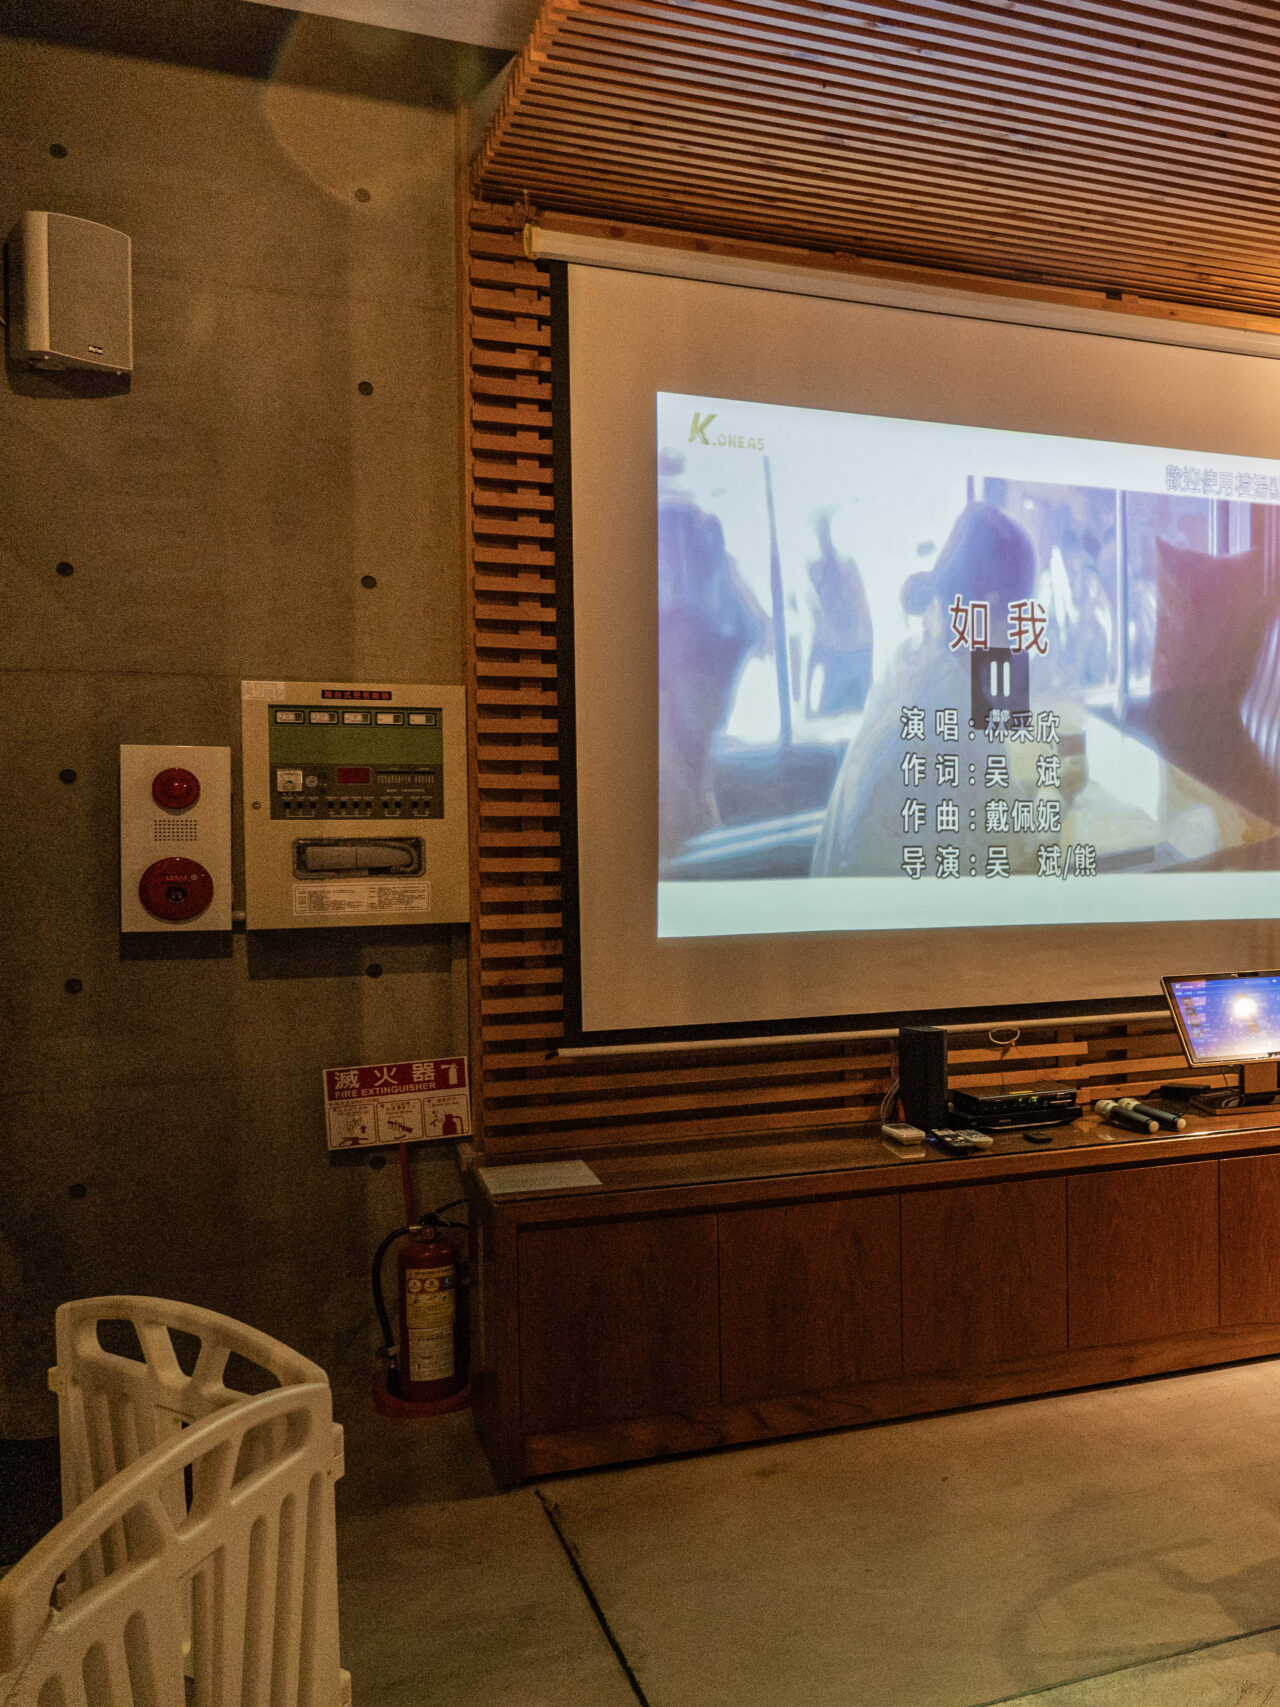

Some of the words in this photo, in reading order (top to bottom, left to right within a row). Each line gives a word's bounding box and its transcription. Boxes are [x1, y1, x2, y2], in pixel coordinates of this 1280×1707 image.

[334, 1062, 435, 1090] 滅火器
[335, 1089, 358, 1099] FIRE
[361, 1082, 436, 1096] EXTINGUISHER
